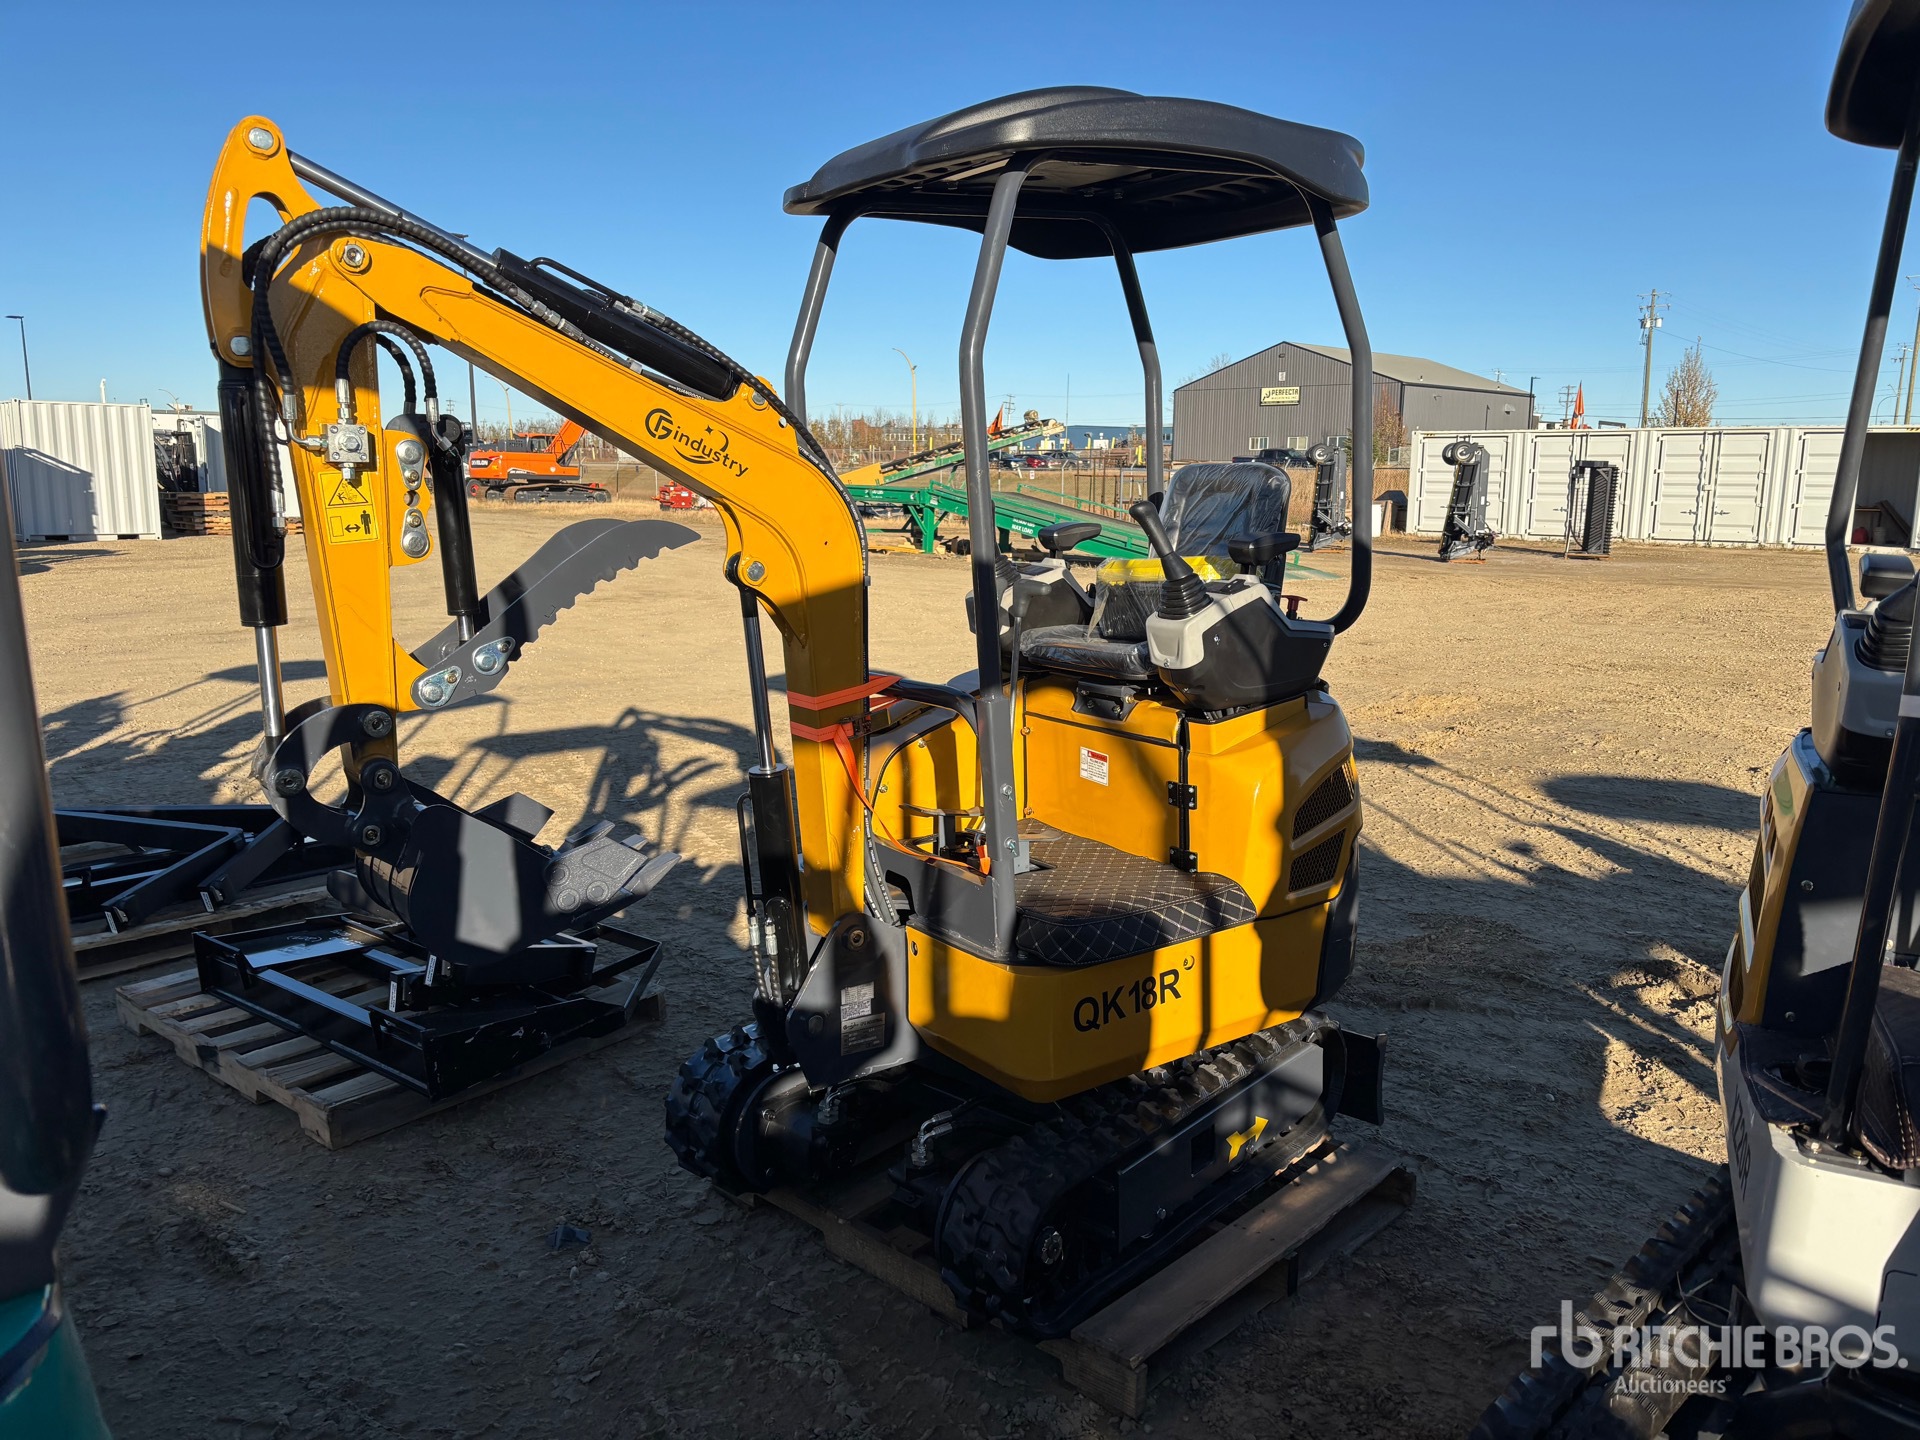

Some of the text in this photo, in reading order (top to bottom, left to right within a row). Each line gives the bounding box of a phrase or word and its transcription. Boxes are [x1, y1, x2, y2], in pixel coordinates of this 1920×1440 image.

[645, 408, 749, 477] Gindustry
[1011, 523, 1021, 531] MAX
[1021, 526, 1033, 535] LOAD
[1073, 968, 1182, 1032] QK18R
